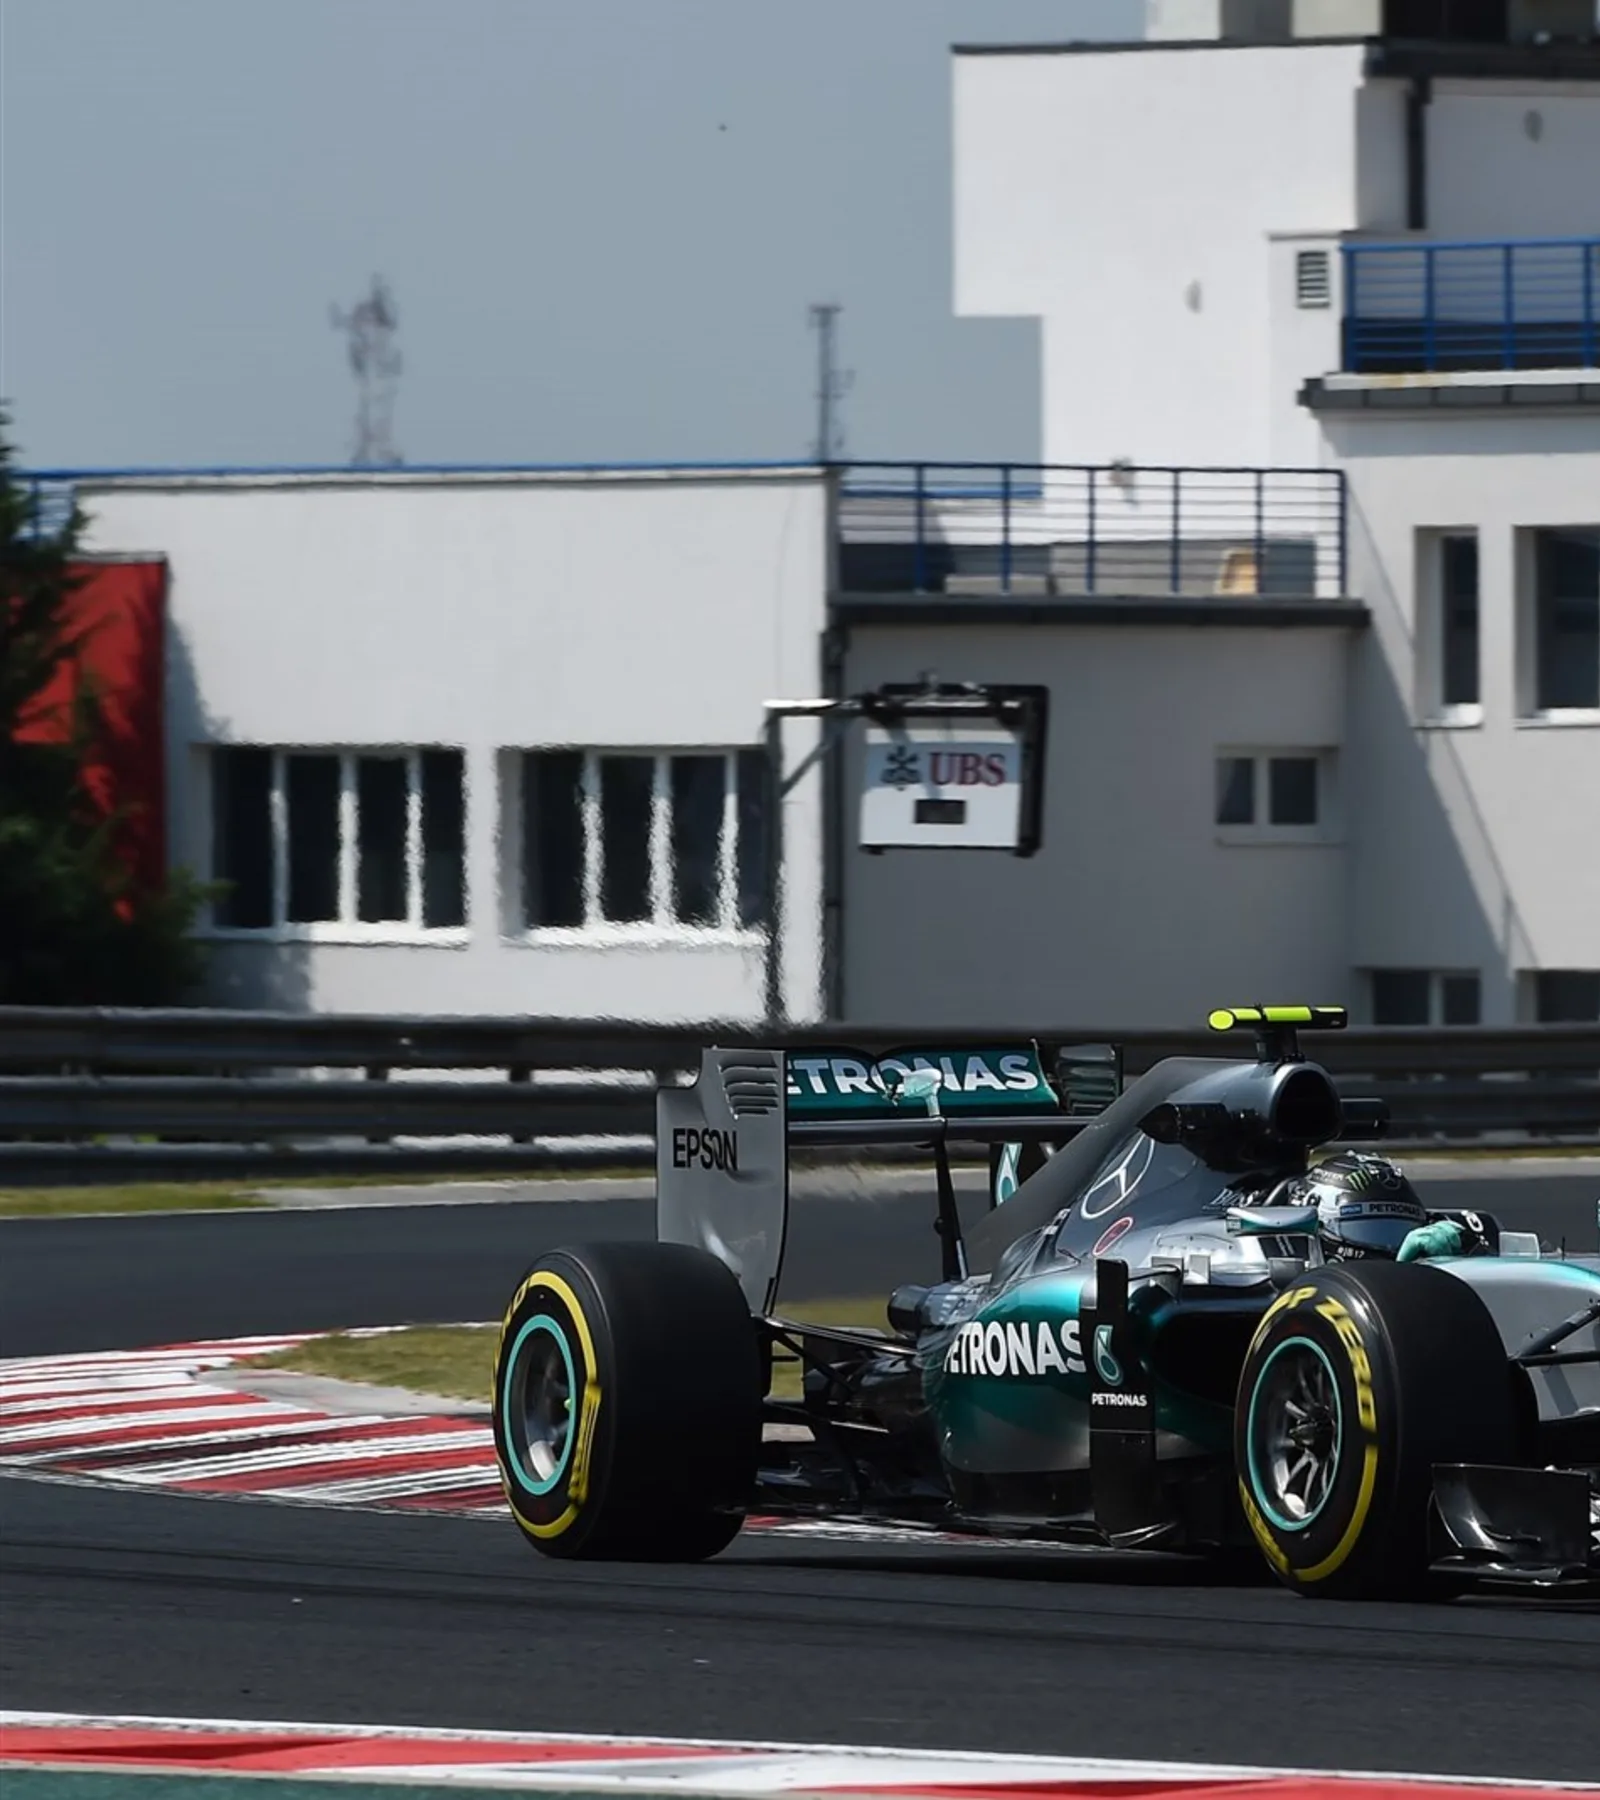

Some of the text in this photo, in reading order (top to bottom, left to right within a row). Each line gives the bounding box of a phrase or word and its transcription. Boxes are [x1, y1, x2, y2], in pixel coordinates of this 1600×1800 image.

[929, 752, 1006, 787] UBS
[673, 1127, 738, 1171] EPSON
[1090, 1392, 1148, 1407] PETRONAS
